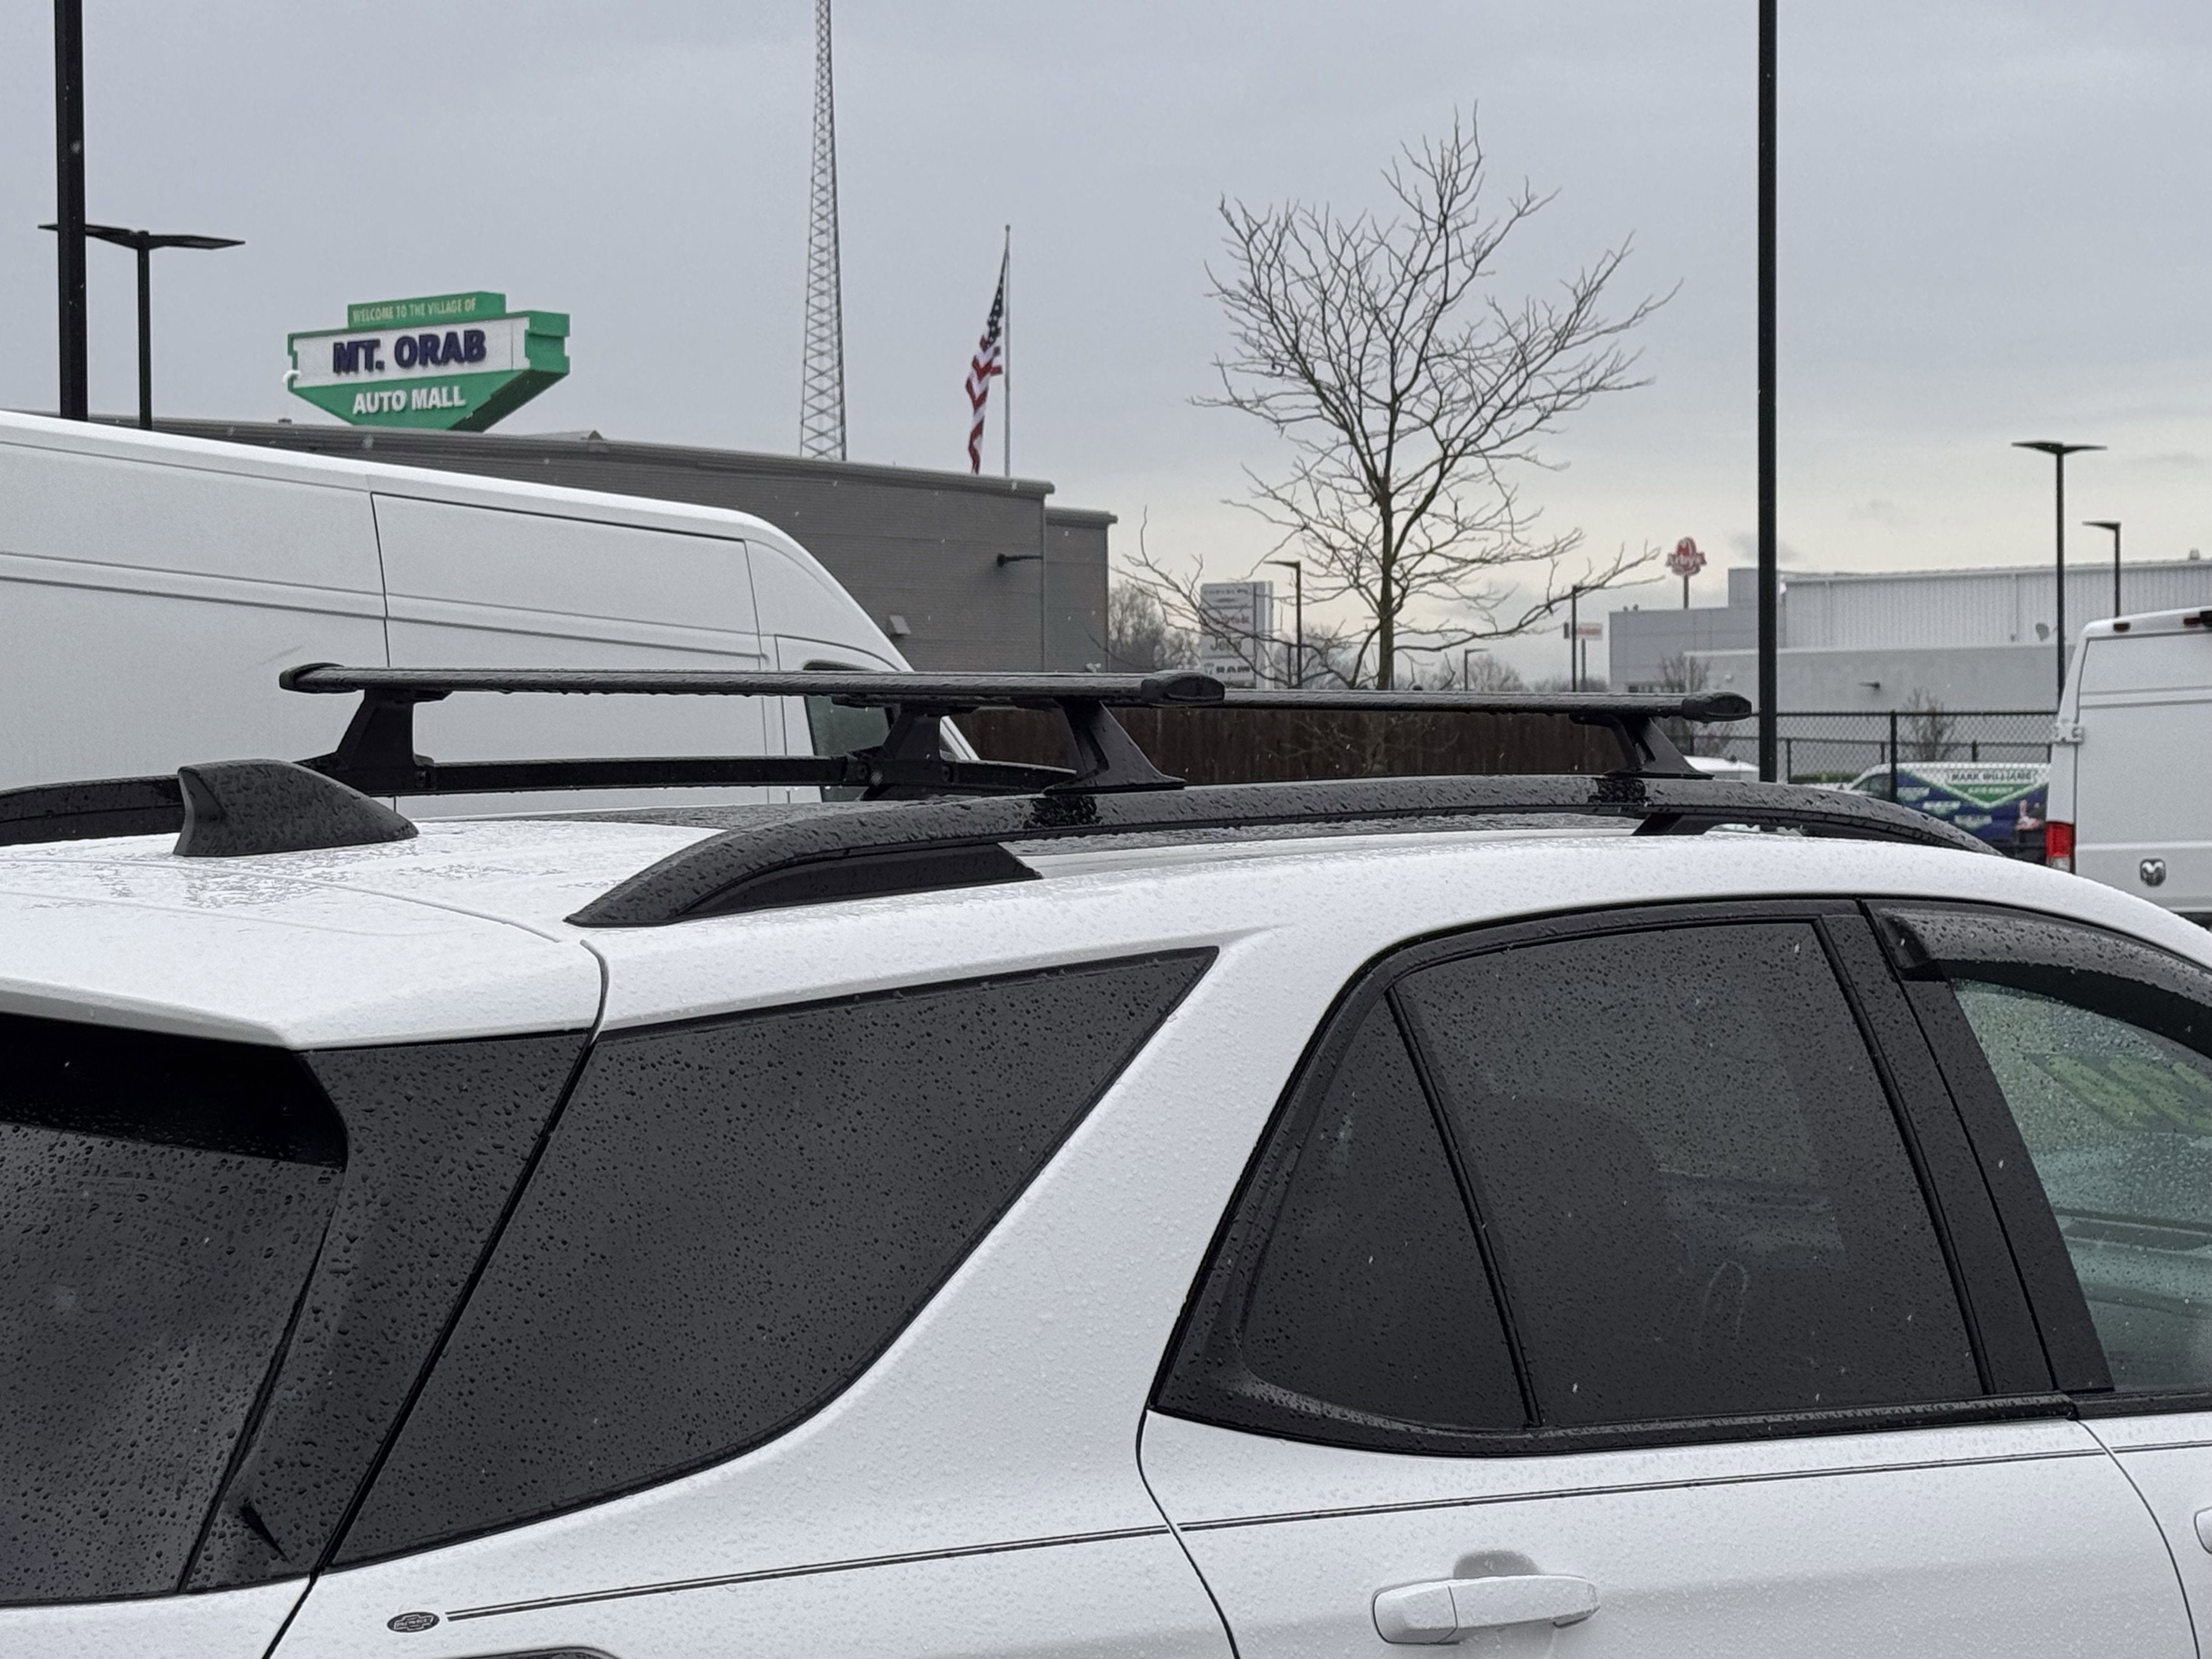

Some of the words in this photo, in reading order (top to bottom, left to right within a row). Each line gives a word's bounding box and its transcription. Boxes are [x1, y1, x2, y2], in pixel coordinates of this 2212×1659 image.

[353, 306, 393, 323] WELCOME
[396, 304, 407, 318] TO
[410, 303, 425, 317] THE
[427, 299, 462, 315] VILLAGE
[465, 297, 476, 311] OF
[333, 338, 385, 374] MT.
[394, 329, 487, 369] ORAB
[353, 390, 407, 415] AUTO
[412, 386, 466, 410] MALL
